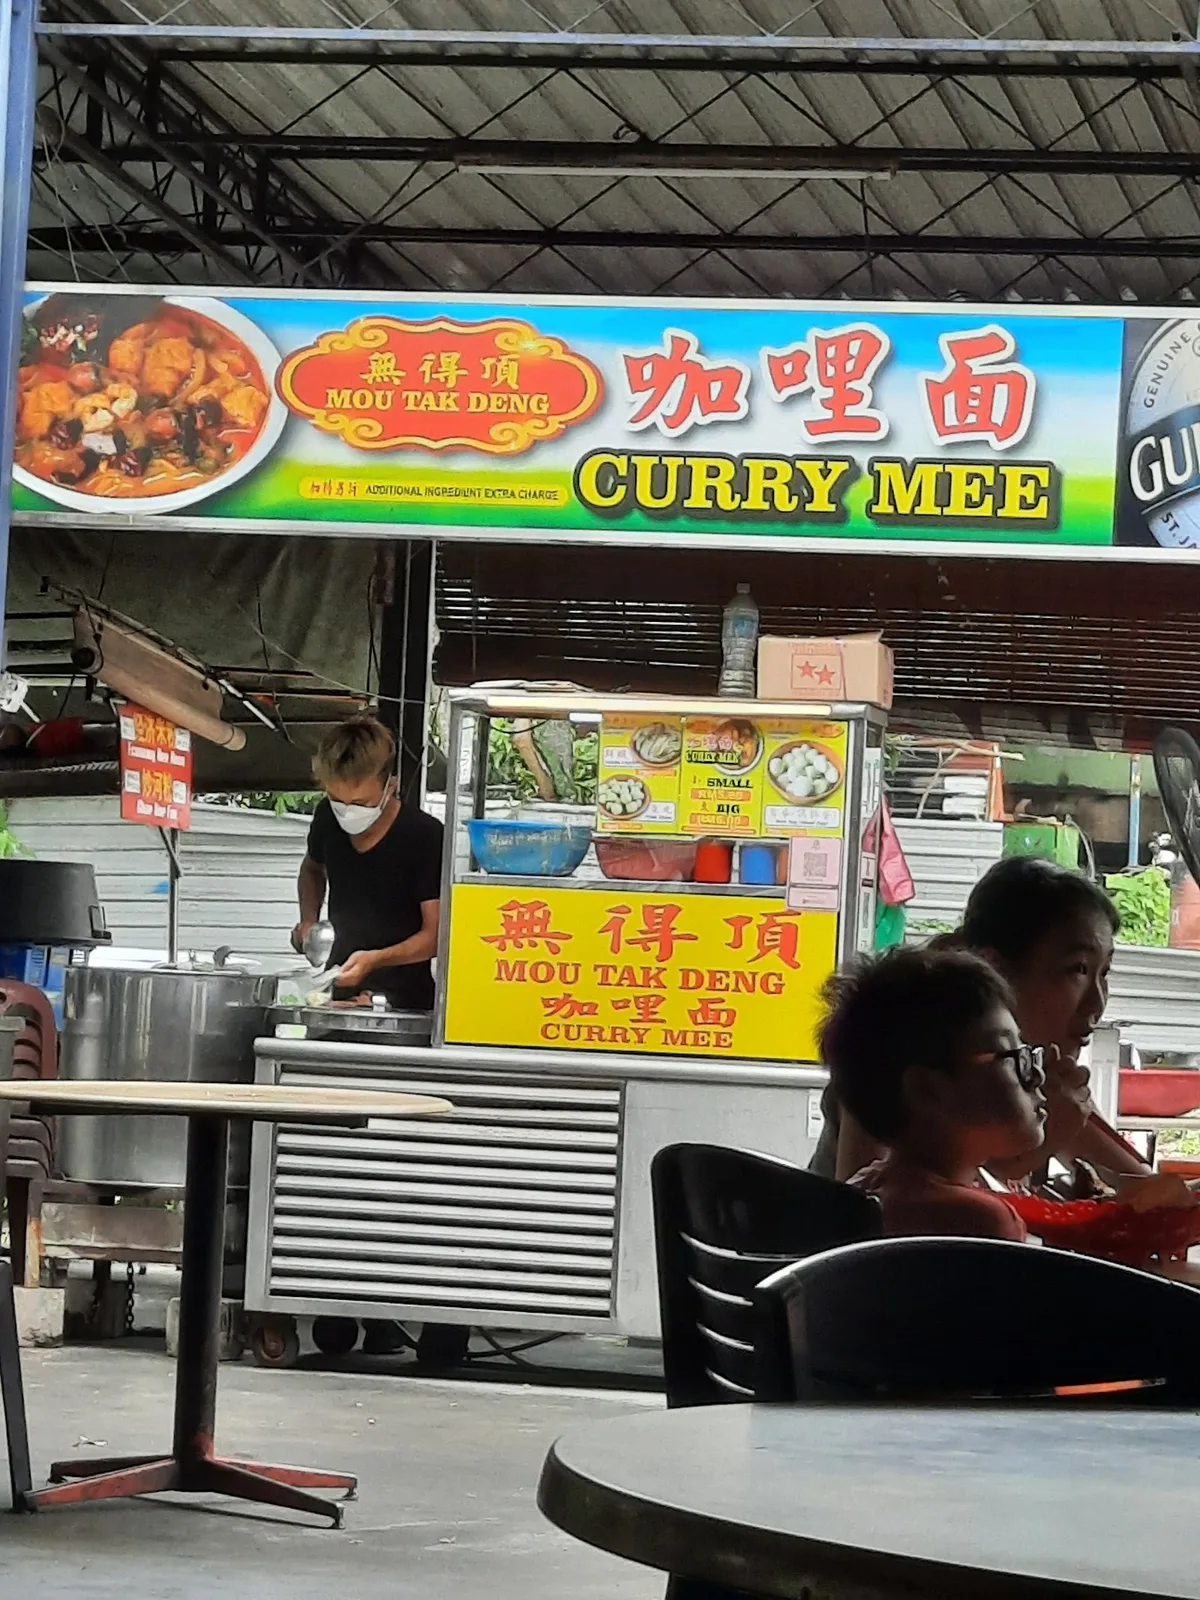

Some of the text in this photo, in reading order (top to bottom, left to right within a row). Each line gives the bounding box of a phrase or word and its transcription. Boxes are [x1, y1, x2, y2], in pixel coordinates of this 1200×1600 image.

[622, 327, 1030, 446] 咖哩面
[1143, 332, 1191, 408] GENUINE
[325, 388, 550, 415] MOU TAK DENG
[365, 484, 422, 497] ADDITIONAL
[484, 488, 517, 500] EXTRA
[518, 489, 559, 501] CHARGE
[576, 451, 1051, 519] CURRY MEE
[707, 777, 754, 789] SMALL
[716, 803, 740, 814] BIG
[480, 899, 802, 969] 無得頂
[494, 958, 786, 996] MOU TAK DENG
[540, 993, 737, 1029] 咖哩面
[540, 1022, 734, 1049] CURRY MEE
